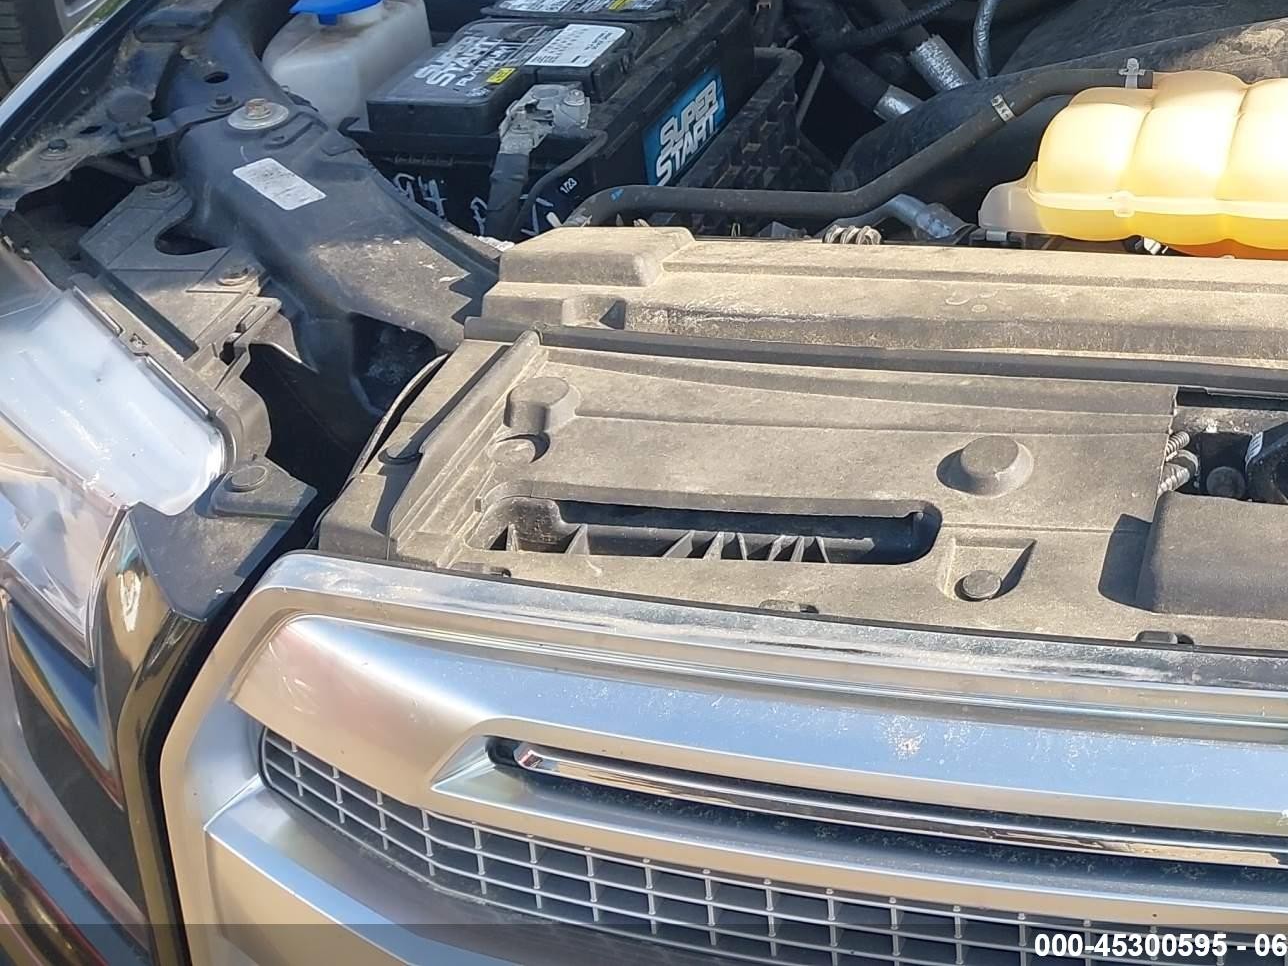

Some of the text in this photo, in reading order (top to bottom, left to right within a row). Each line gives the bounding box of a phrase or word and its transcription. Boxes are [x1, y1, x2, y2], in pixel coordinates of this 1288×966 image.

[656, 101, 719, 186] START
[660, 80, 718, 145] SUPER
[560, 177, 577, 193] 1/23
